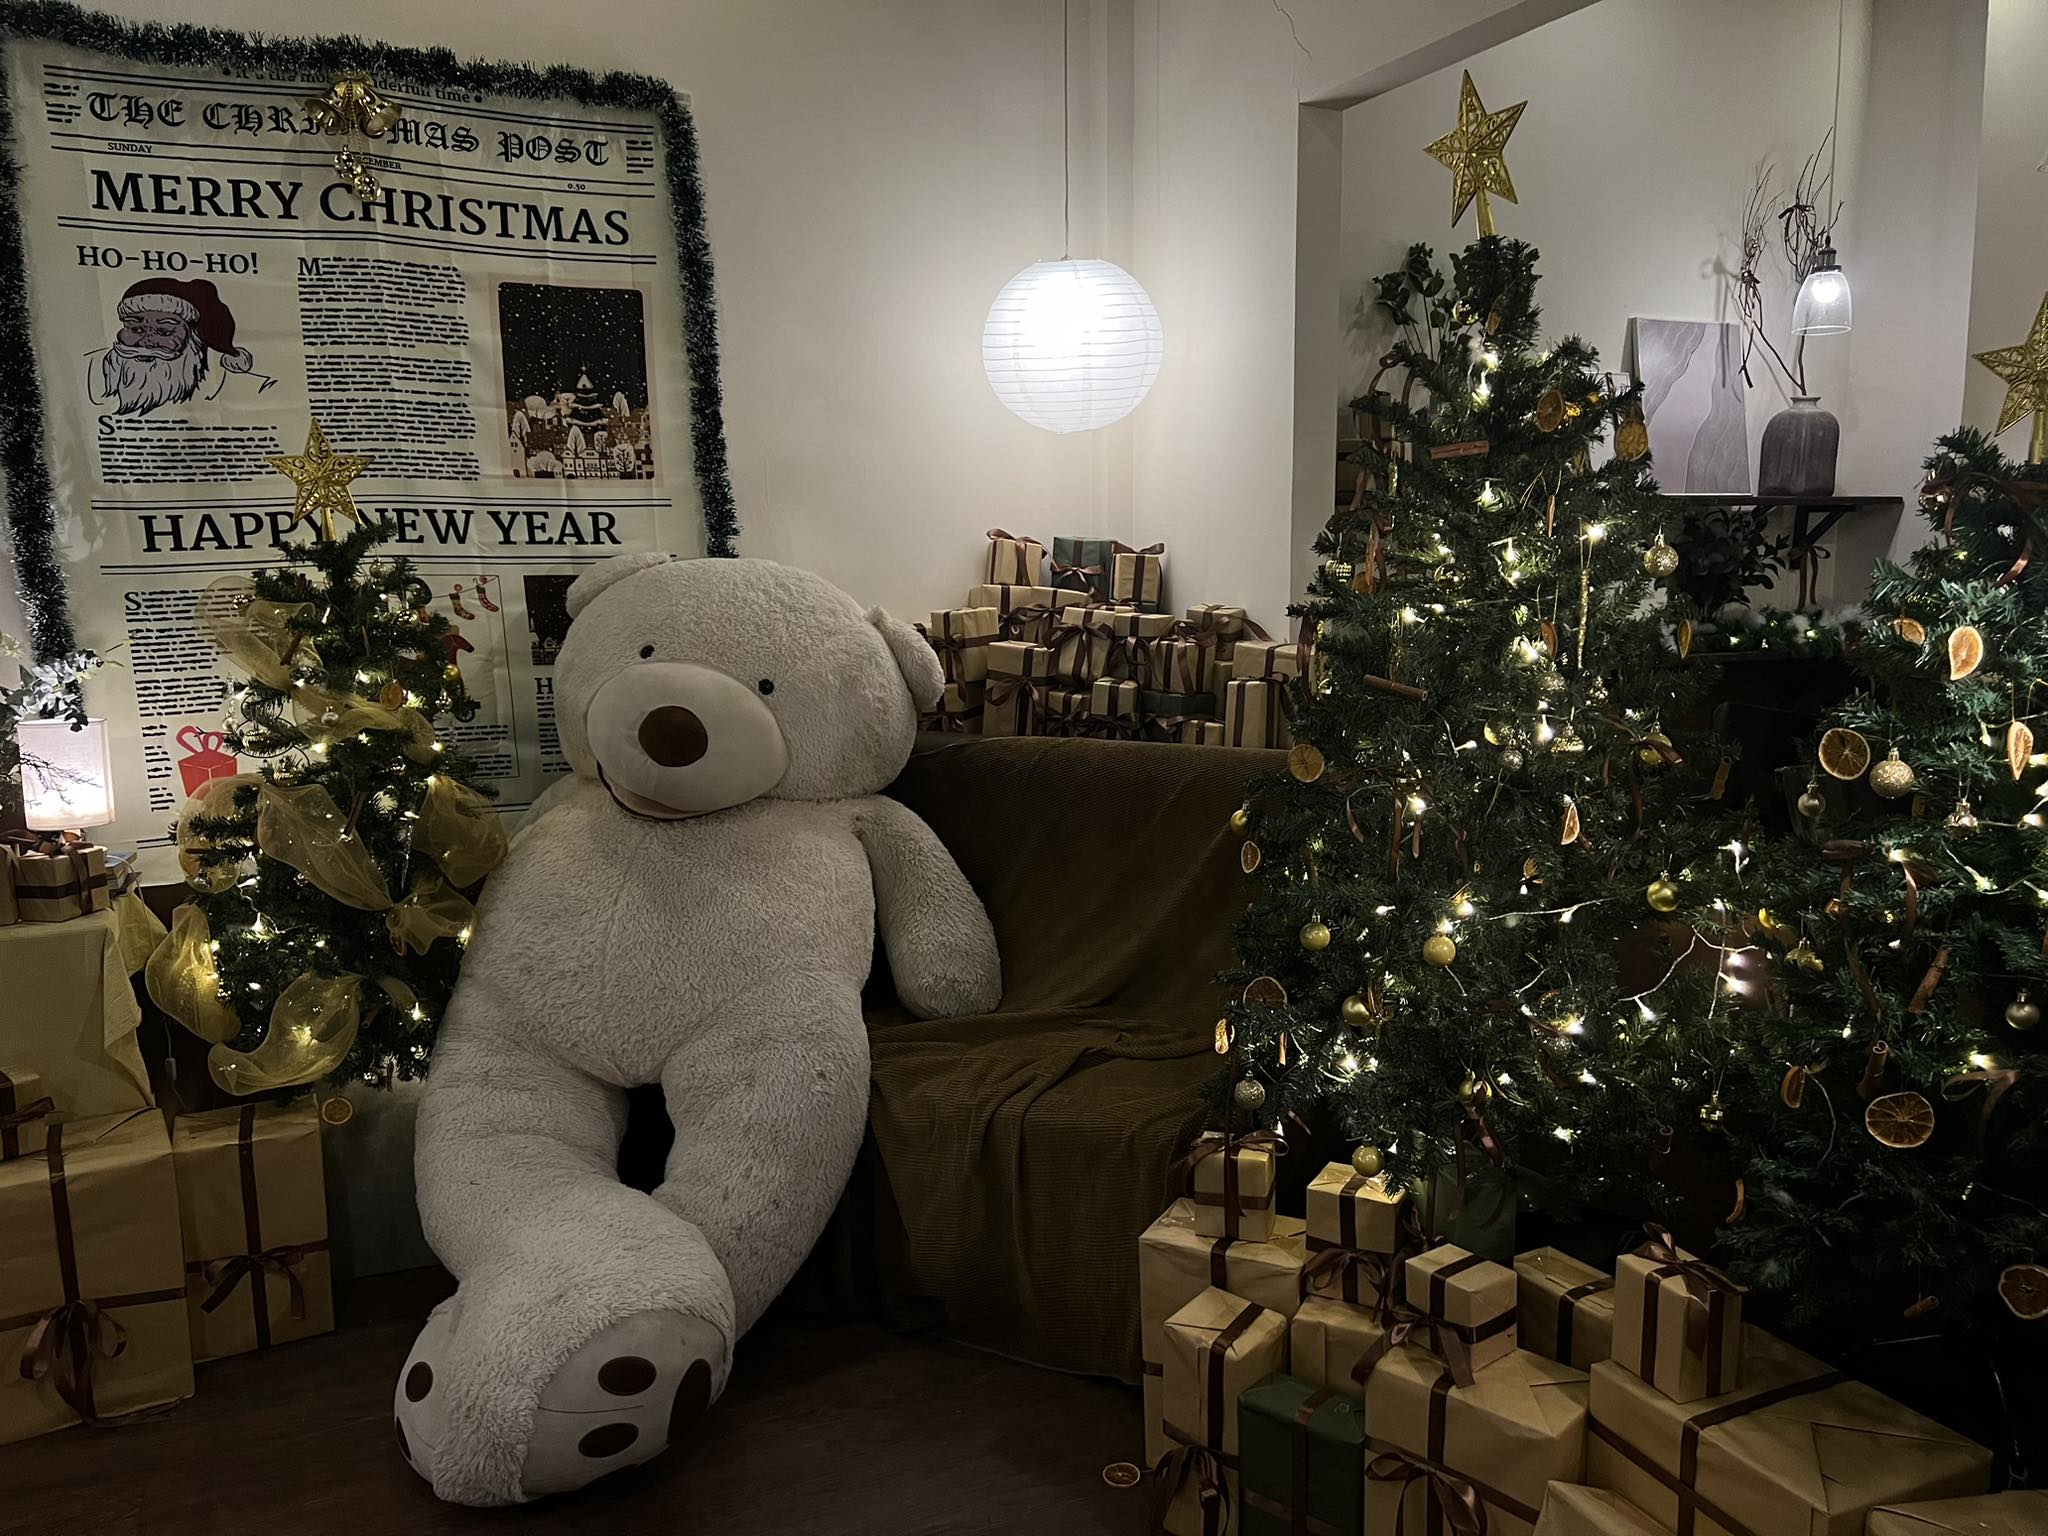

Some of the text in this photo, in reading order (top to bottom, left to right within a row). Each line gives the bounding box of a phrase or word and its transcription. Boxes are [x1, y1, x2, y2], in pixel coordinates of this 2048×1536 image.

[436, 86, 470, 103] time
[86, 91, 187, 130] THE
[202, 102, 480, 152] CHRIMAS
[497, 130, 610, 167] POST
[107, 141, 153, 154] SUNDAY
[357, 156, 402, 170] CEMBER
[566, 183, 586, 191] 0.50
[91, 169, 630, 246] MERRY CHRISTMAS
[76, 245, 259, 275] HO-HO-HO!
[486, 511, 622, 546] YEAR
